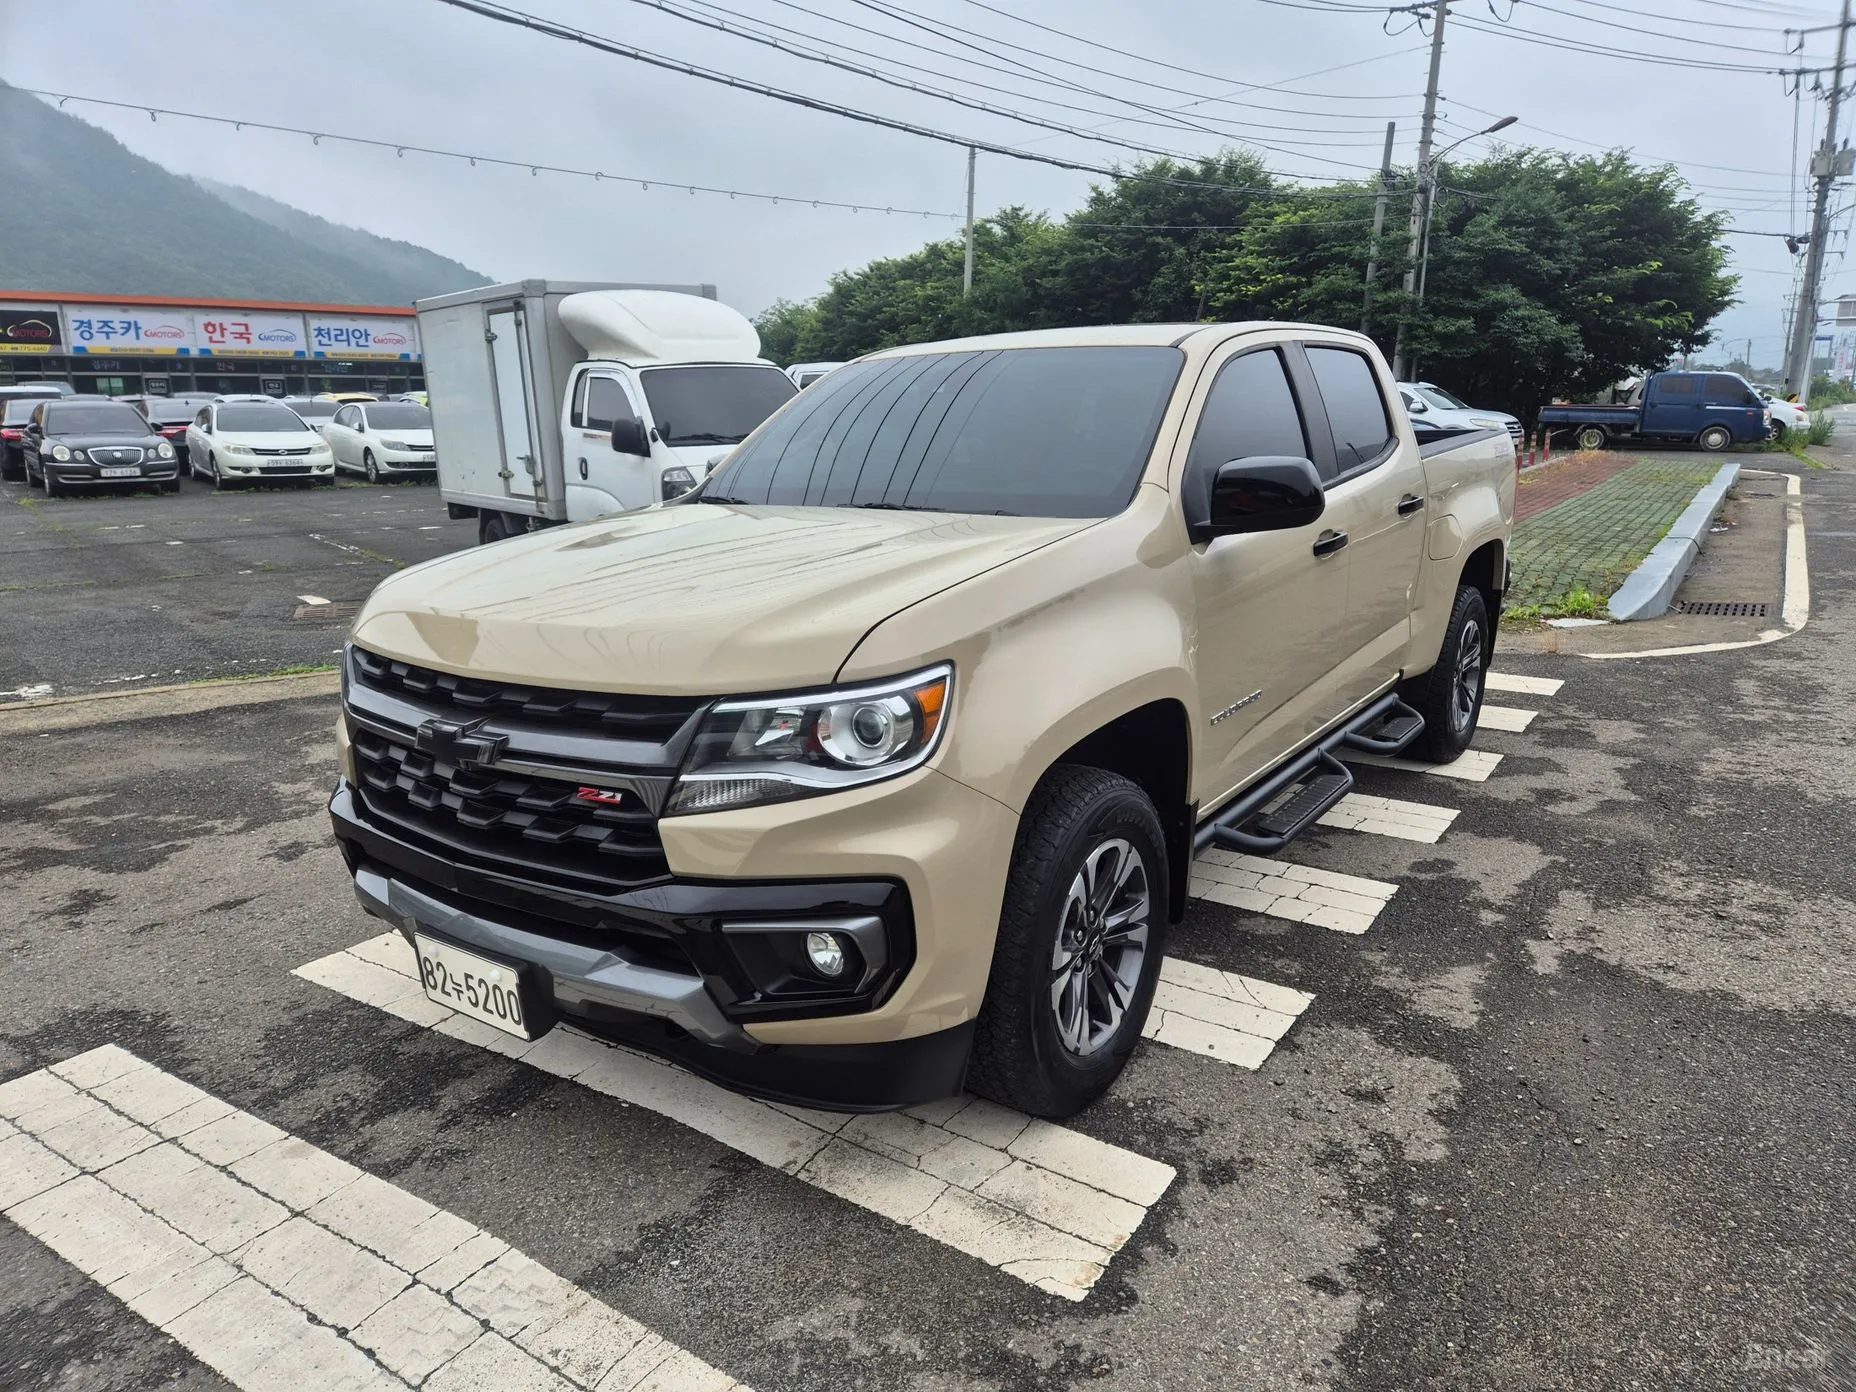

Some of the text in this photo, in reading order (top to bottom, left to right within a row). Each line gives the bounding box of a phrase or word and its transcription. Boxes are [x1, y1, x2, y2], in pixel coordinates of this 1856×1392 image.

[72, 319, 182, 341] 경주카 MOTORS
[203, 321, 252, 344] 한국
[313, 326, 371, 347] 천리안
[422, 956, 522, 1026] 82누5200
